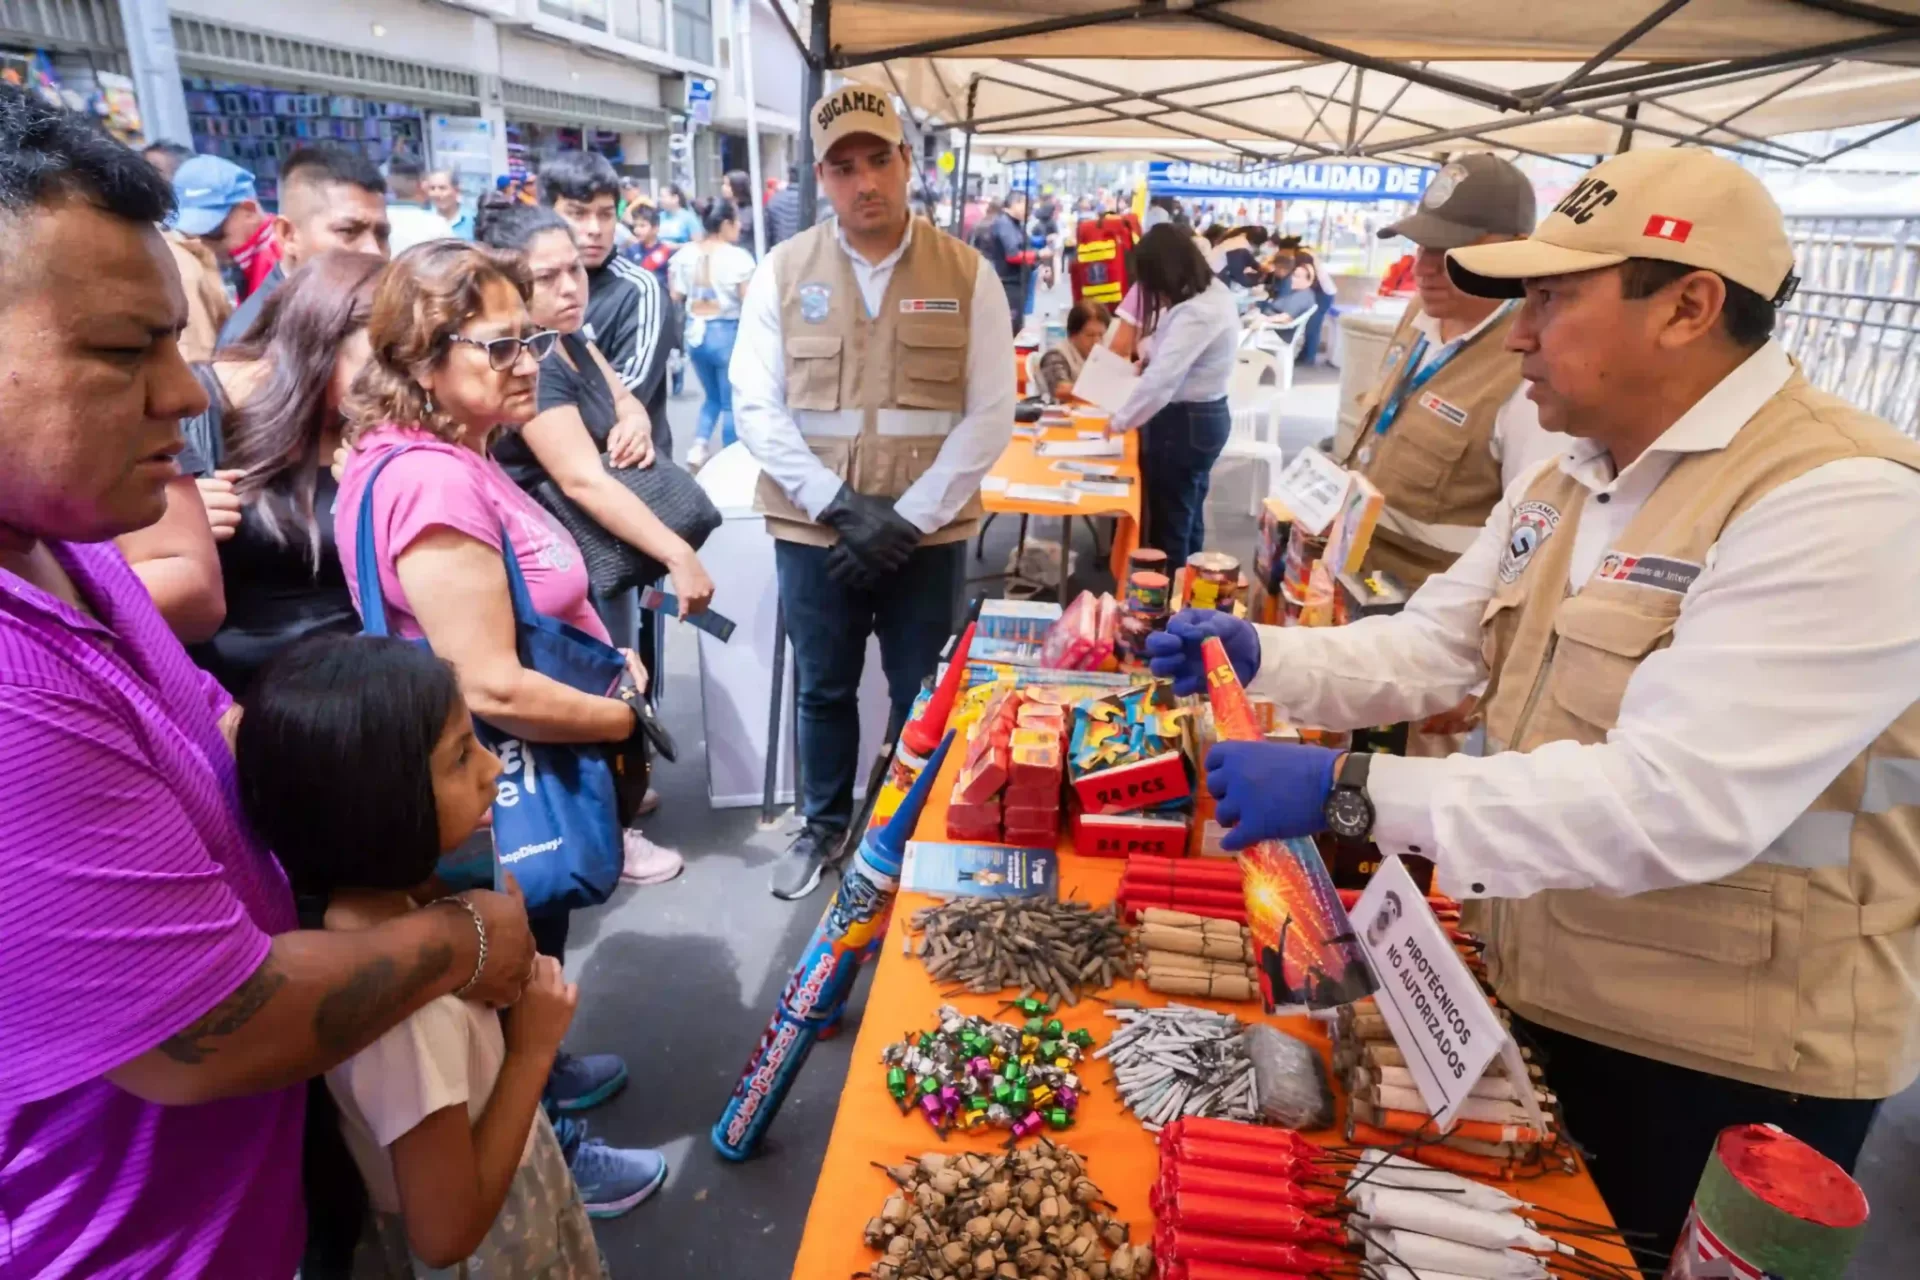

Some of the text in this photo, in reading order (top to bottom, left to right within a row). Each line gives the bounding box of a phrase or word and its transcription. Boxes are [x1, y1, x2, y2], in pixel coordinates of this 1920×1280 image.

[817, 91, 886, 130] SUCAMEC
[1187, 162, 1381, 192] MUNICIPALIDAD
[1385, 166, 1420, 193] DE
[1207, 664, 1234, 689] 15
[1127, 777, 1166, 798] PCS
[1404, 935, 1471, 1046] PIROTÉCNICOS
[1386, 943, 1466, 1080] NO AUTORIZADOS
